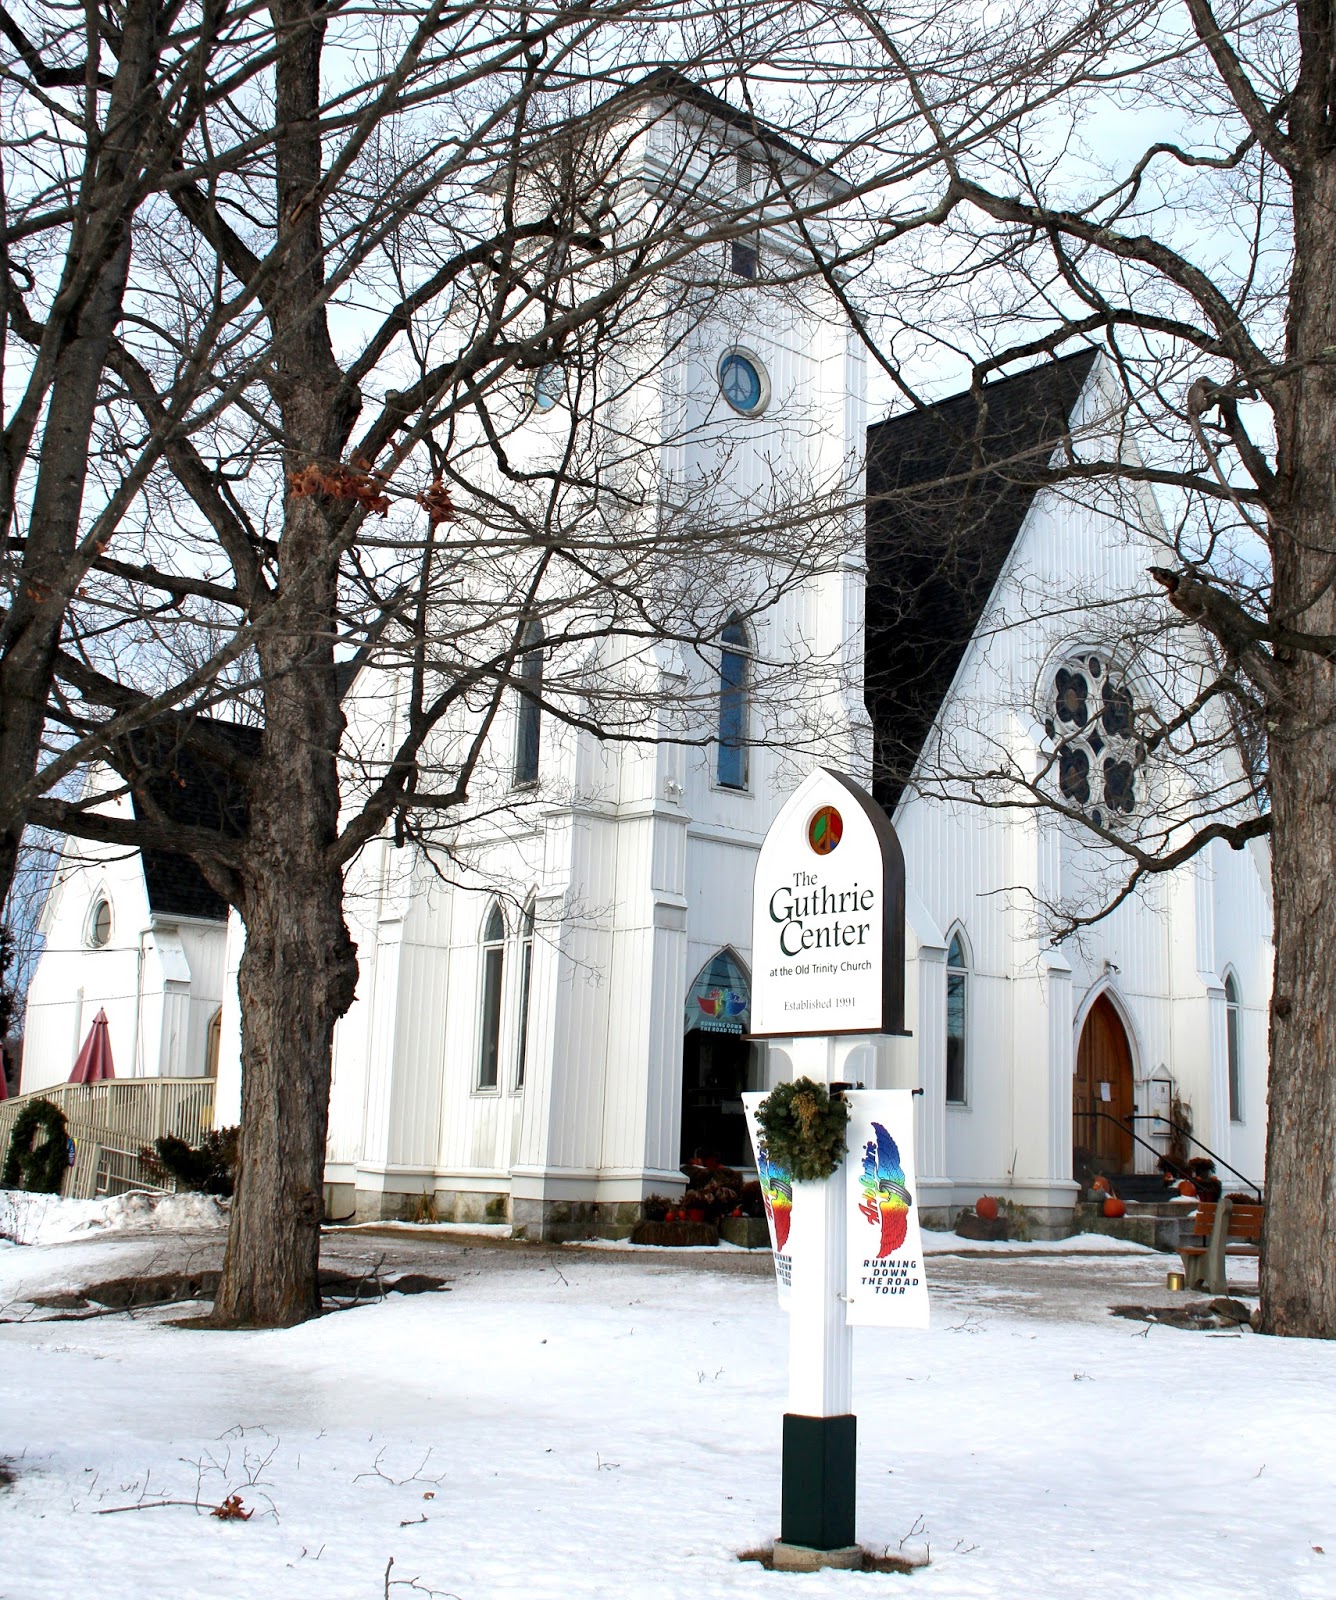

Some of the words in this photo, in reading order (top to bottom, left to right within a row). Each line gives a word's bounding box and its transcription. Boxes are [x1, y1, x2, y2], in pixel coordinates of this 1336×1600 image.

[793, 871, 818, 887] The
[769, 882, 874, 923] Guthrie
[780, 920, 870, 956] Center
[769, 968, 778, 977] at
[780, 966, 793, 976] the
[795, 964, 810, 975] Old
[812, 963, 838, 974] Trinity
[840, 960, 872, 971] Church
[784, 998, 832, 1011] Established
[835, 997, 856, 1008] 1991
[863, 1259, 917, 1269] RUNNING
[873, 1268, 908, 1277] DOWN
[861, 1277, 883, 1285] THE
[887, 1278, 919, 1286] ROAD
[875, 1286, 906, 1295] TOUR
